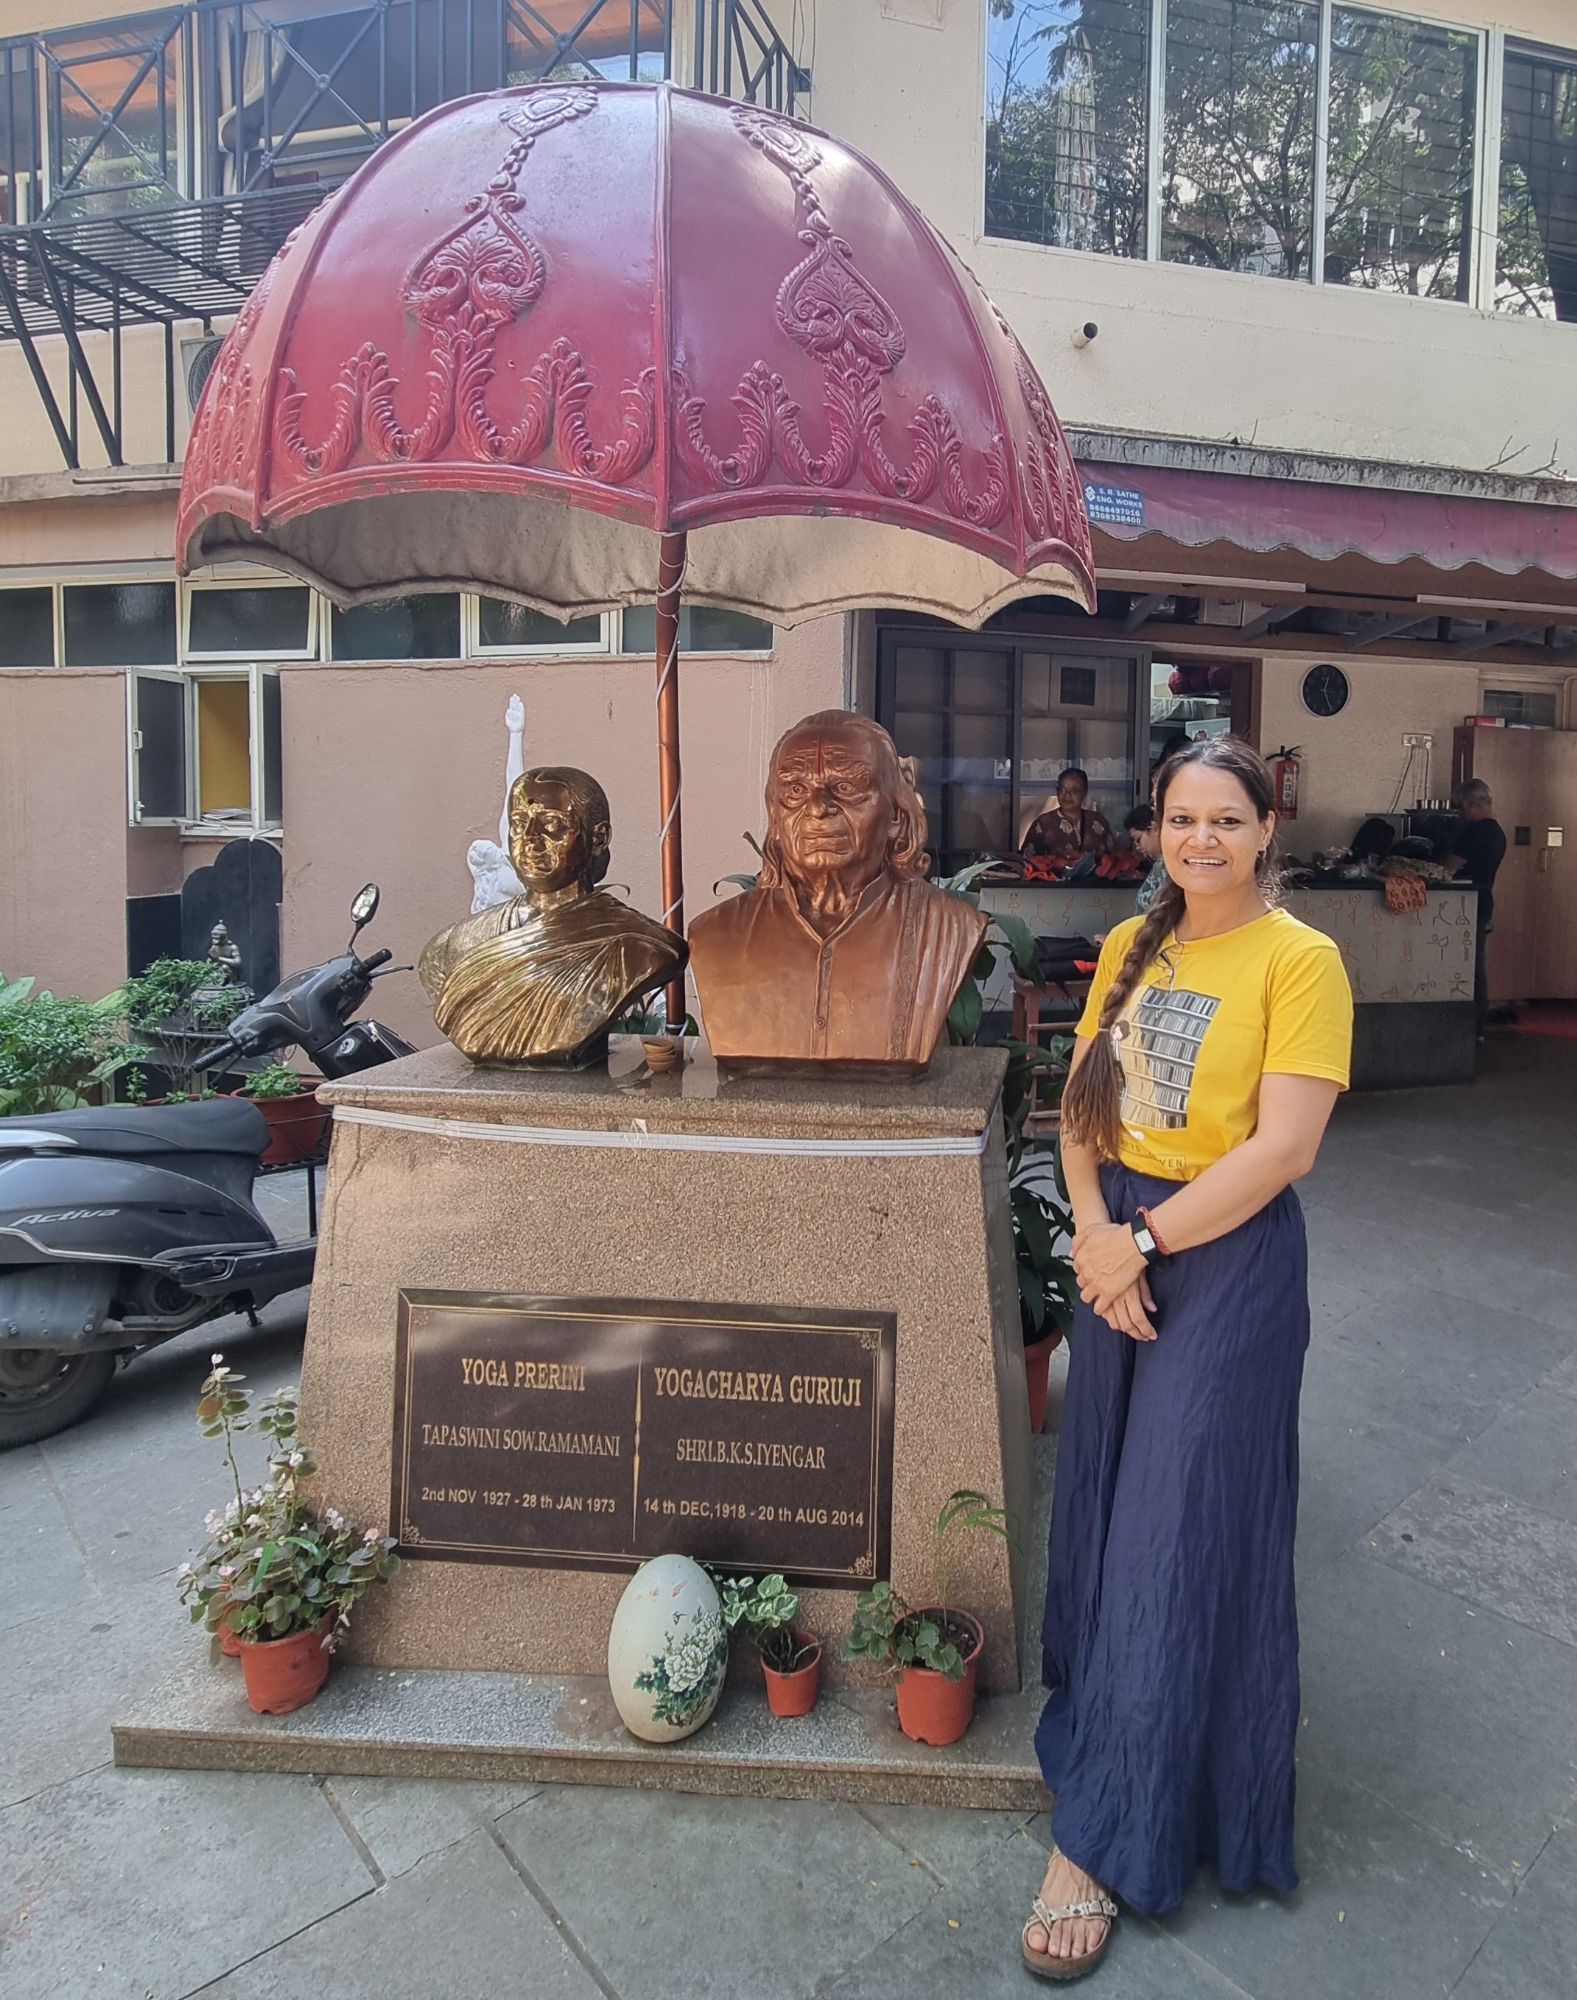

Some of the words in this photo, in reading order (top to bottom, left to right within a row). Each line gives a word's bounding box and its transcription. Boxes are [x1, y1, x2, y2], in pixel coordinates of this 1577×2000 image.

[1115, 498, 1142, 508] WORKS
[1116, 490, 1139, 499] SATHE
[8, 1209, 120, 1227] Activa
[461, 1358, 509, 1387] YOGA
[514, 1361, 586, 1391] PRERINI
[654, 1367, 784, 1403] YOGACHARYA
[789, 1375, 862, 1406] GURUJI
[421, 1424, 500, 1449] TAPASWINI
[503, 1428, 621, 1457] SOW.RAMAMANI
[676, 1438, 826, 1469] SHRI.B.K.S.IYENGAR
[421, 1487, 445, 1502] 2nd
[448, 1489, 477, 1504] NOV
[482, 1491, 511, 1506] 1927
[522, 1494, 537, 1507] 28
[540, 1495, 553, 1509] th
[556, 1497, 583, 1511] JAN
[586, 1499, 616, 1513] 1973
[643, 1498, 659, 1514] 14
[662, 1500, 676, 1514] th
[680, 1500, 746, 1519] DEC,1918
[758, 1506, 774, 1521] 20
[778, 1507, 791, 1522] th
[795, 1509, 827, 1525] AUG
[831, 1510, 864, 1527] 2014
